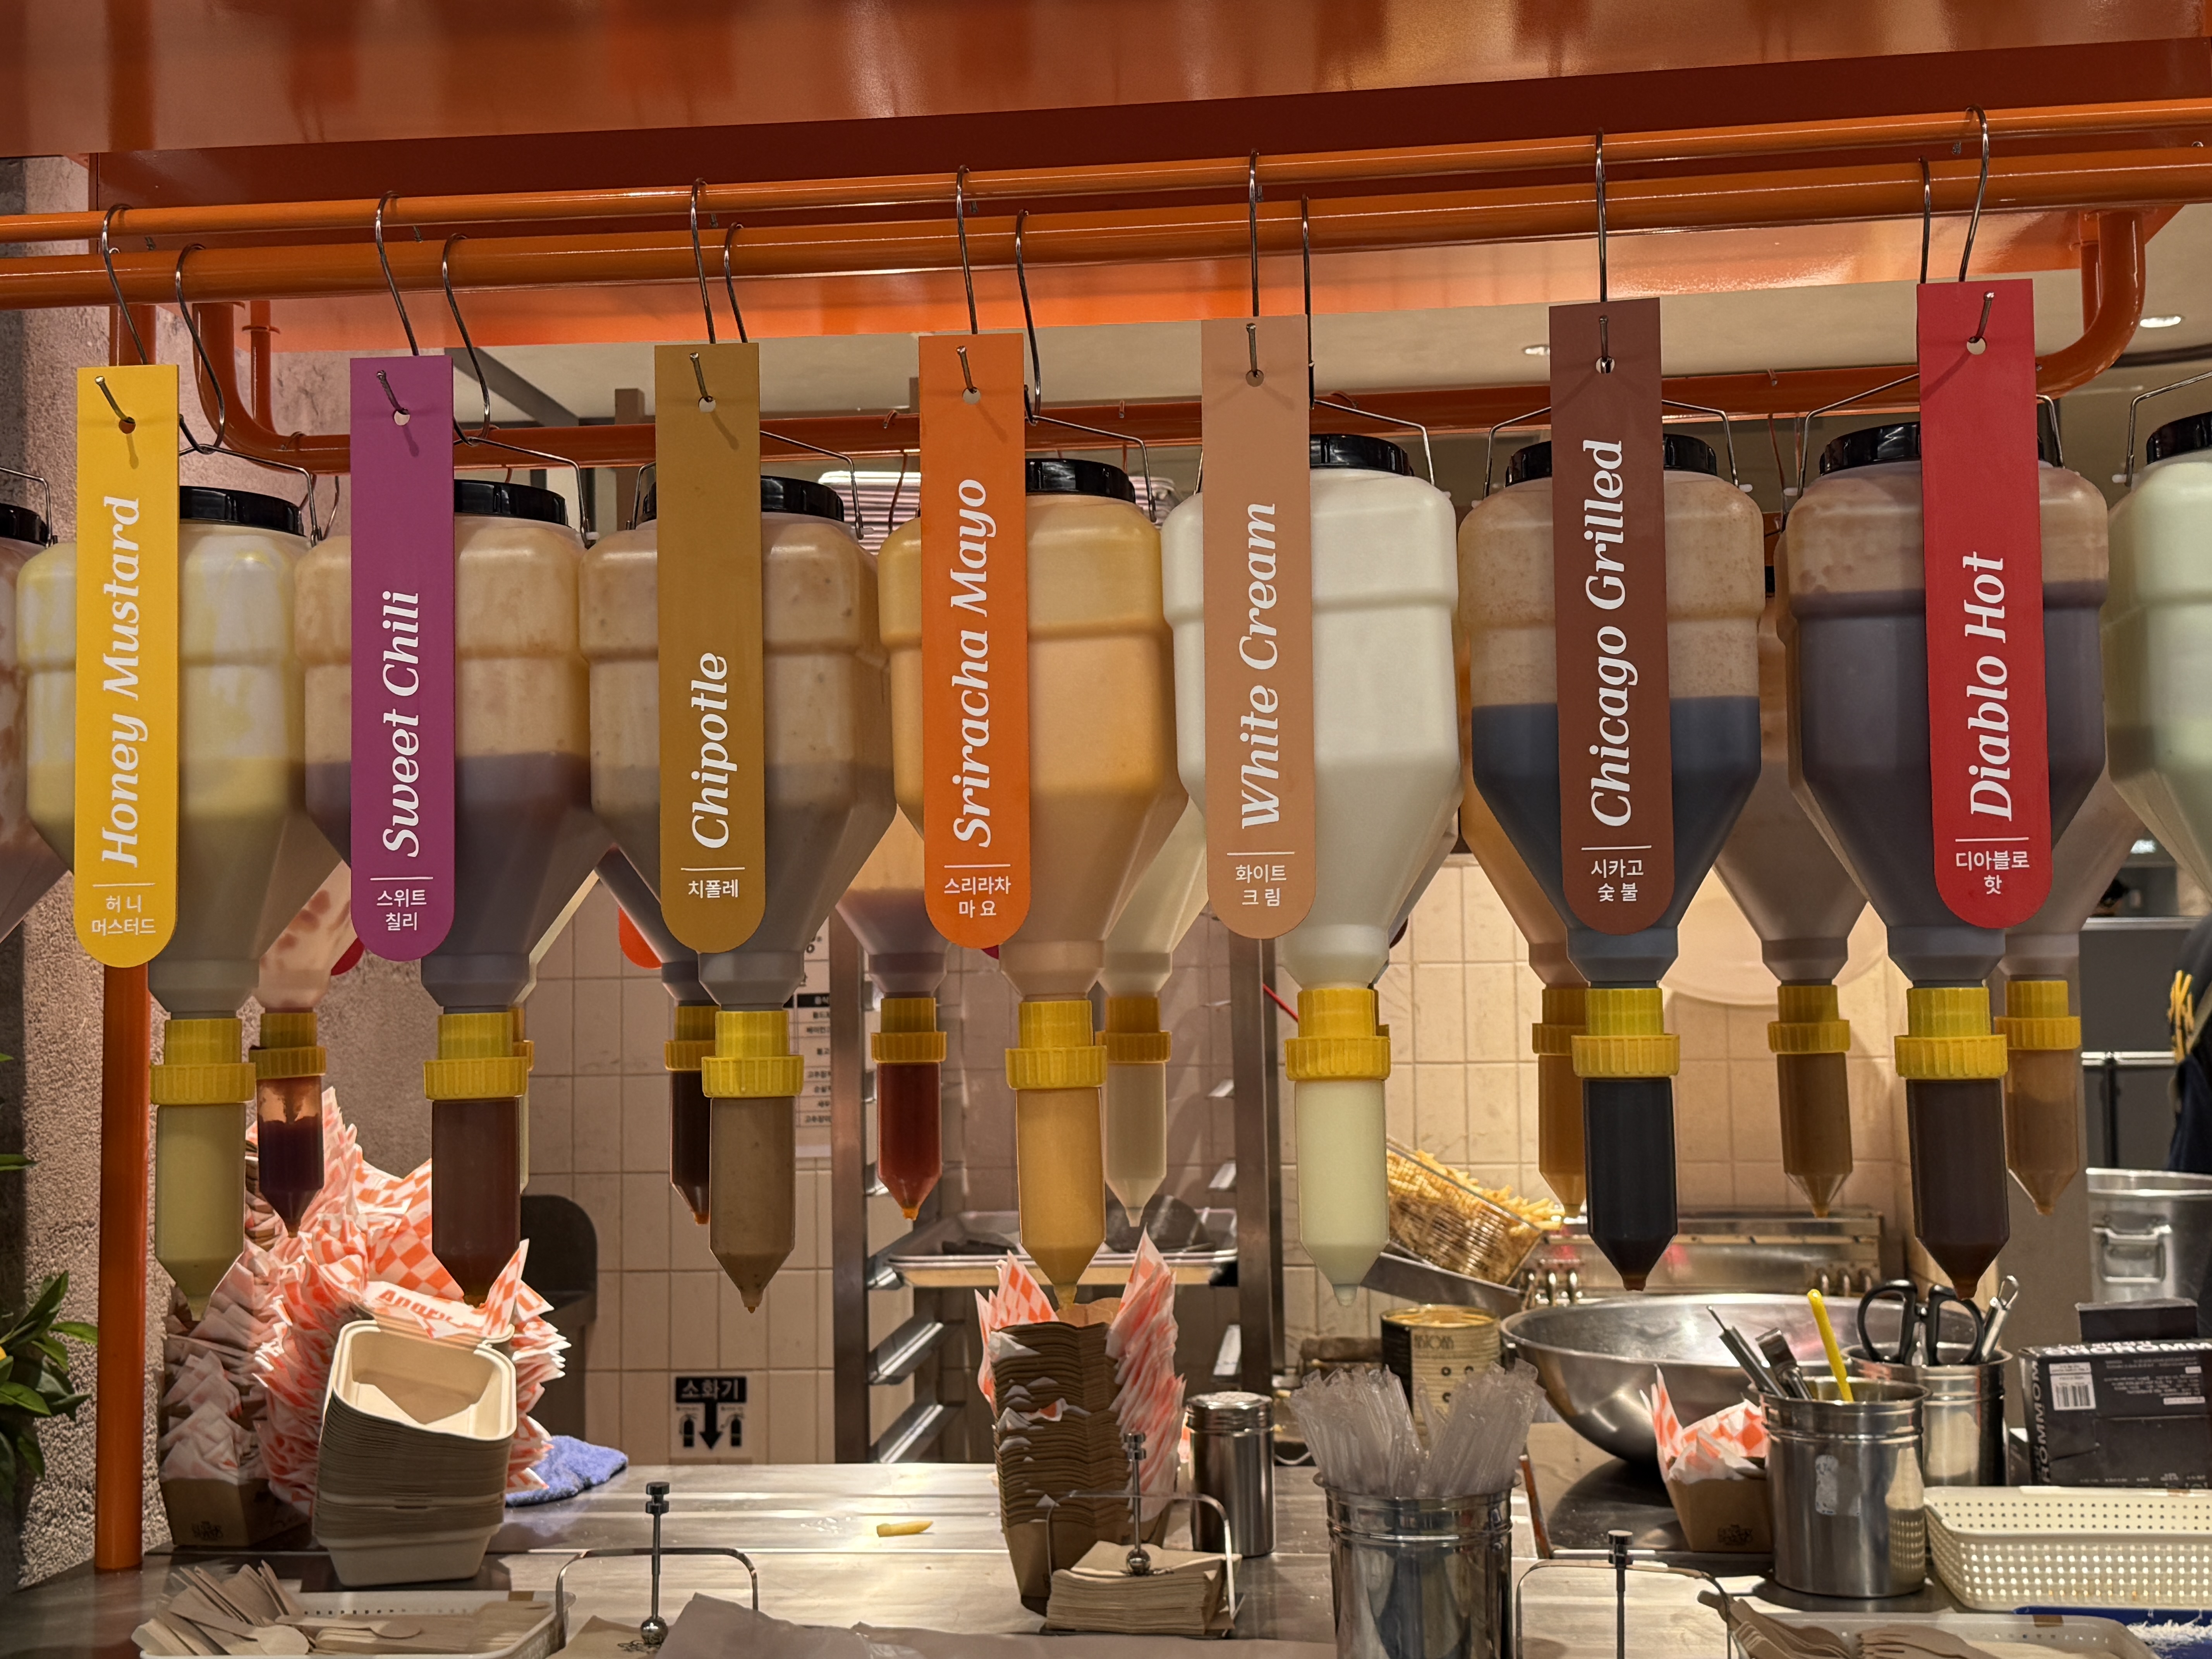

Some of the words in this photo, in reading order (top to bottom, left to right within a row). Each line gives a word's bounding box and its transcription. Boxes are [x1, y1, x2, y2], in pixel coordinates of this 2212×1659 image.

[950, 479, 996, 617] Mayo
[1583, 440, 1625, 610] Grilled
[103, 496, 139, 701] Mustard
[1239, 503, 1278, 670] Cream
[1963, 551, 2006, 644] Hot
[382, 591, 419, 696] Chili
[691, 653, 737, 848] Chipotle
[951, 630, 991, 848] Sriracha
[1240, 685, 1279, 829] White
[1589, 626, 1638, 826] Chicago
[1966, 656, 2012, 821] Diablo
[102, 713, 148, 868] Honey
[383, 708, 419, 857] Sweet
[376, 888, 427, 907] 스위트
[689, 879, 738, 898] 치폴레
[944, 876, 1011, 895] 스리라차
[1235, 864, 1287, 883] 화이트
[1591, 859, 1644, 878] 시카고
[1956, 850, 2030, 871] 디아블로
[1984, 874, 2002, 895] 핫
[92, 917, 156, 936] 머스터드
[386, 912, 417, 931] 칠리
[682, 1379, 738, 1399] 소화기
